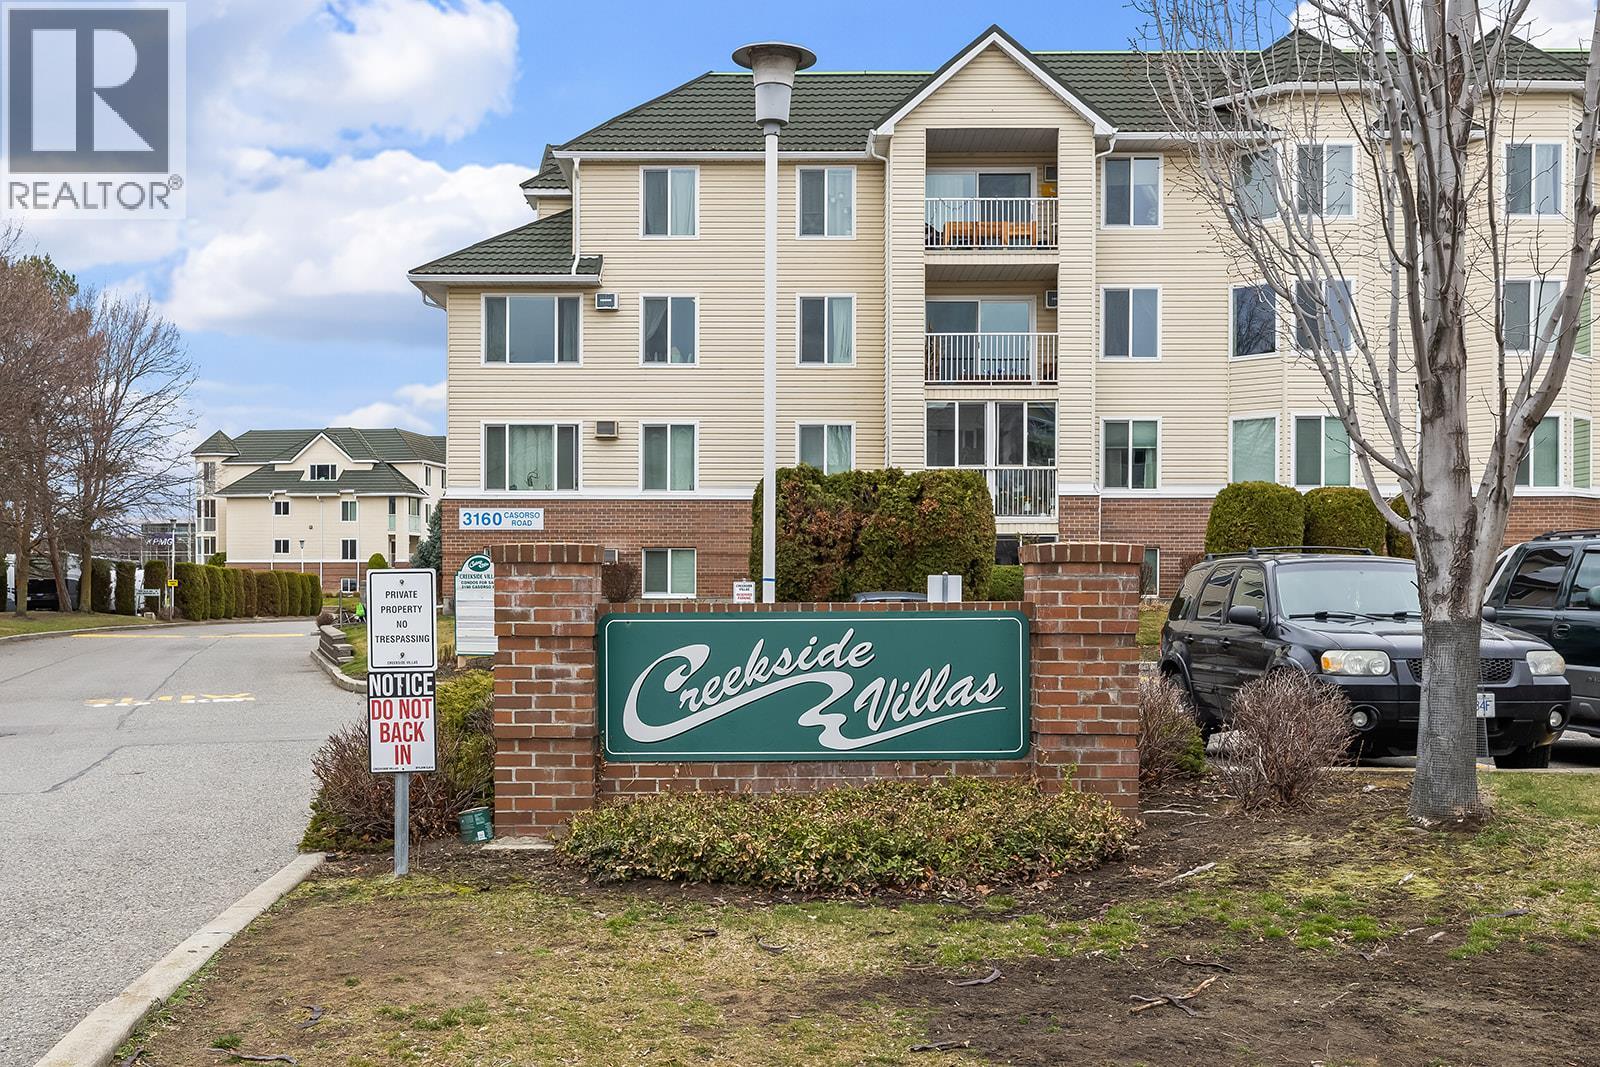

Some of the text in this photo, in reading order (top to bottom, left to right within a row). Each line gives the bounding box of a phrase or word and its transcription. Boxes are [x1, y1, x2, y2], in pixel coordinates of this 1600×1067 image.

[462, 512, 503, 526] 3160
[503, 511, 540, 519] CASORSO
[511, 519, 533, 527] ROAD
[385, 590, 418, 599] PRIVATE
[380, 605, 423, 614] PROPERTY
[396, 620, 408, 629] NO
[375, 635, 430, 643] TRESPASSING
[369, 672, 434, 698] NOTICE
[623, 628, 1004, 743] Creekside Villas
[371, 698, 433, 721] DO NOT
[379, 721, 425, 744] BACK
[394, 744, 412, 766] IN
